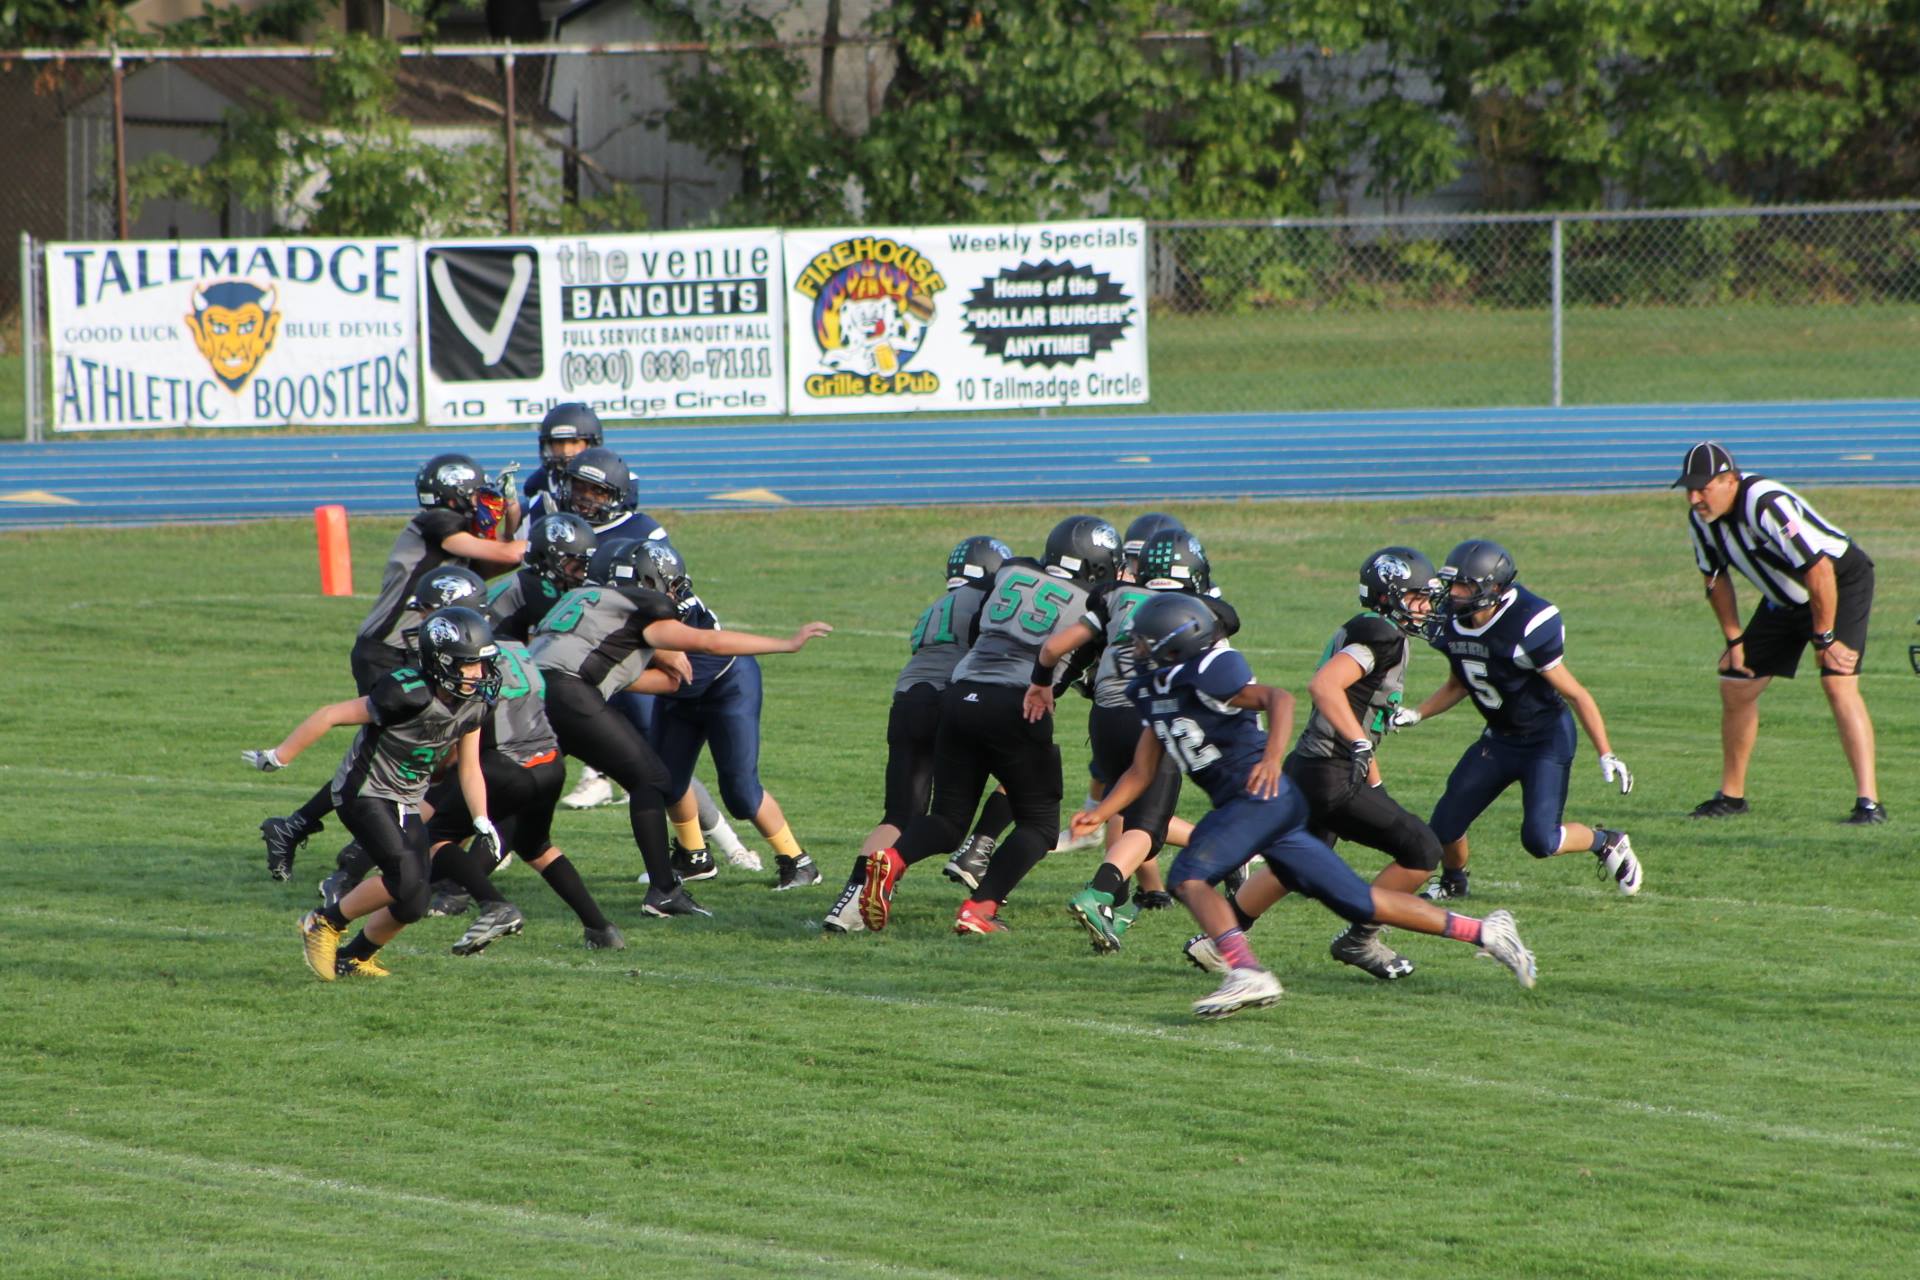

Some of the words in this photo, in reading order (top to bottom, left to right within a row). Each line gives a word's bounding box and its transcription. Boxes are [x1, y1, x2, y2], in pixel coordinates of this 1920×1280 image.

[950, 233, 1031, 254] Weekly
[1040, 228, 1138, 253] Specials
[64, 245, 400, 308] TALLMADGE
[557, 242, 629, 284] the
[642, 246, 769, 278] venue
[794, 236, 946, 300] FIREHOUSE
[572, 282, 759, 319] BANQUETS
[993, 278, 1043, 298] Home
[1047, 276, 1065, 296] of
[1068, 275, 1097, 295] the
[286, 322, 331, 338] BLUE
[340, 320, 402, 337] DEVILS
[968, 306, 1046, 328] "DOLLAR
[1050, 302, 1129, 326] BURGER"
[64, 326, 123, 343] GOOD
[130, 325, 179, 341] LUCK
[562, 330, 595, 346] FULL
[600, 327, 656, 345] SERVICE
[662, 325, 729, 342] BANQUET
[735, 323, 771, 340] HALL
[1004, 335, 1090, 357] ANYTIME!
[61, 356, 219, 422] ATHLETIC
[255, 348, 409, 418] BOOSTERS
[561, 349, 634, 393] (330)
[641, 347, 771, 382] 633-7111
[805, 374, 865, 397] Grille
[869, 374, 888, 394] &
[895, 371, 940, 394] Pub
[443, 400, 485, 417] 10
[508, 395, 666, 417] Taladge
[676, 390, 767, 409] Circle
[956, 378, 975, 401] 10
[983, 376, 1079, 406] Tallmadge
[1088, 373, 1142, 396] Circle
[990, 572, 1073, 636] 55
[1461, 659, 1503, 710] 5
[1153, 717, 1223, 771] 12
